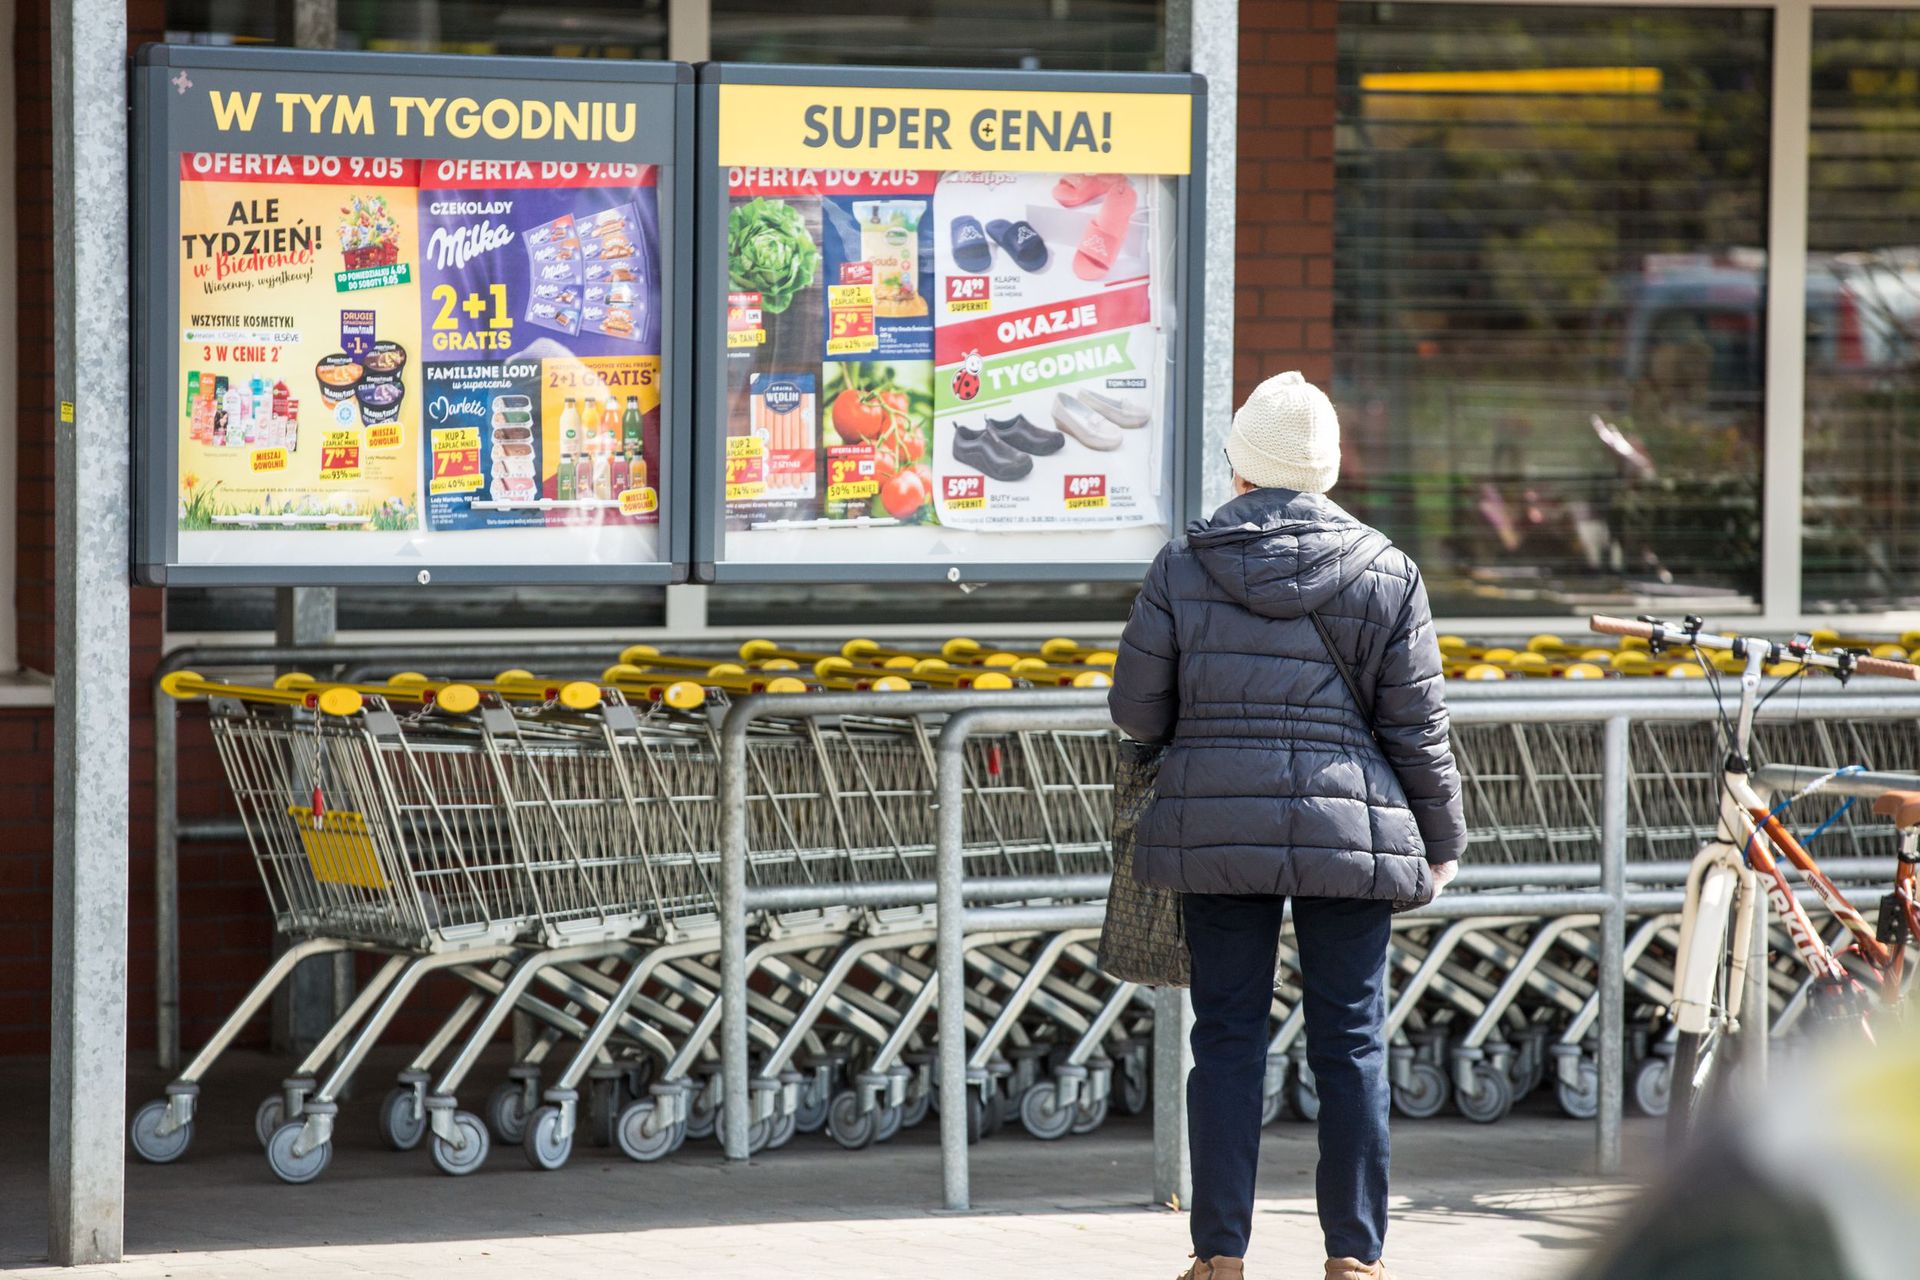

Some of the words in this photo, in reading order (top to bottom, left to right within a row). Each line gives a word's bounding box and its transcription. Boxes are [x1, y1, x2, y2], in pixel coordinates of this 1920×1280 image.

[209, 90, 262, 131] W
[275, 93, 375, 135] TYM
[390, 96, 636, 142] TYGODNIU
[803, 104, 952, 149] SUPER
[970, 108, 1112, 153] CENA!
[192, 152, 294, 177] OFERTA
[303, 155, 340, 177] DO
[350, 157, 403, 179] 9.05
[437, 159, 534, 180] OFERTA
[541, 161, 578, 180] DO
[728, 167, 818, 187] OFERTA
[825, 169, 856, 187] DO
[227, 198, 279, 225] ALE
[430, 201, 512, 216] CZEKOLADY
[182, 218, 322, 259] TYDZIEŃ!
[426, 219, 515, 271] Milka
[193, 263, 211, 278] w
[216, 240, 315, 281] Biedronce!
[994, 275, 1021, 283] KLAPKI
[431, 283, 513, 330] 2+1
[951, 301, 988, 312] SUPERHIT
[191, 314, 240, 327] WSZYSTKIE
[243, 315, 294, 328] KOSMETYKI
[343, 312, 374, 320] DRUGIE
[997, 304, 1097, 343] OKAZJE
[354, 337, 362, 354] 1
[432, 330, 512, 351] GRATIS
[204, 346, 211, 361] 3
[216, 346, 227, 362] W
[233, 346, 266, 362] CENIE
[427, 365, 499, 381] FAMILIJNE
[502, 364, 538, 378] LODY
[986, 344, 1123, 390] TYGODNIA
[550, 372, 576, 388] 2+1
[428, 395, 486, 424] Marletto
[332, 432, 344, 440] KUP
[345, 431, 350, 440] 2
[372, 428, 397, 437] MIESZAJ
[445, 431, 460, 441] KUP
[461, 430, 466, 439] 2
[369, 436, 399, 447] DOWOLNIE
[438, 441, 460, 449] ZAPŁAĆ
[460, 440, 477, 448] MNIEJ
[730, 439, 744, 449] KUP
[746, 438, 750, 448] 2
[256, 451, 281, 461] MIESZAJ
[254, 460, 284, 471] DOWOLNIE
[831, 486, 850, 496] 50%
[852, 485, 876, 493] TANIEJ
[1110, 486, 1129, 494] BUTY
[948, 499, 982, 510] SUPERHIT
[1068, 498, 1105, 509] SUPERHIT
[1755, 870, 1829, 978] ARKUS
